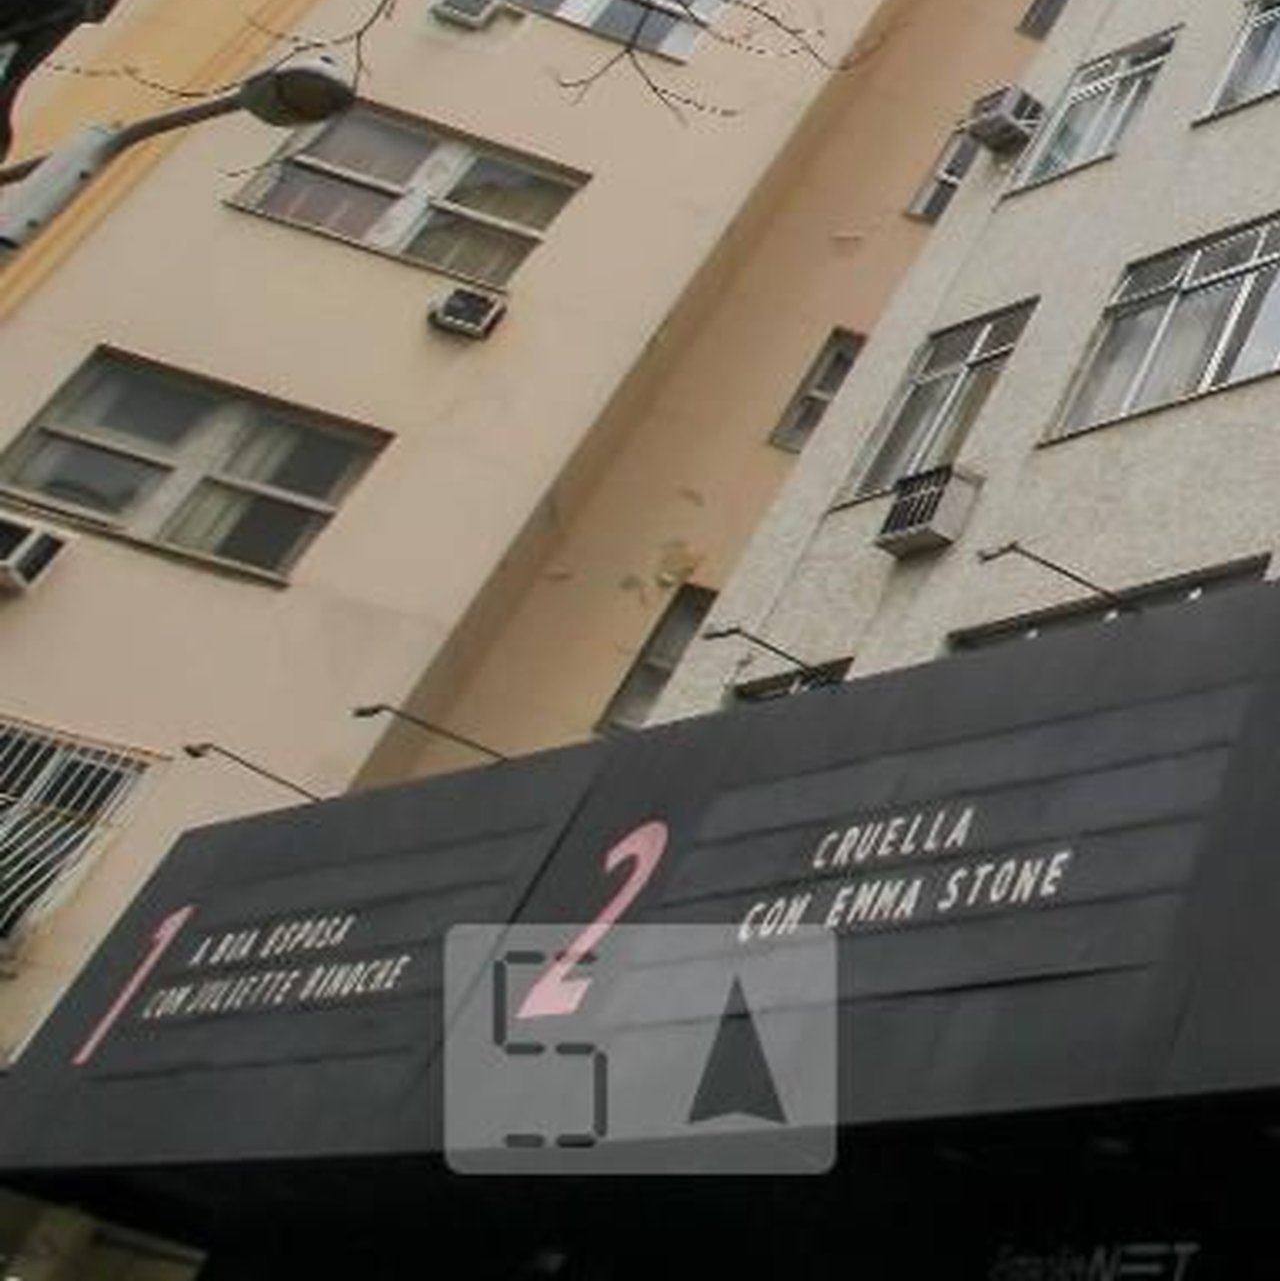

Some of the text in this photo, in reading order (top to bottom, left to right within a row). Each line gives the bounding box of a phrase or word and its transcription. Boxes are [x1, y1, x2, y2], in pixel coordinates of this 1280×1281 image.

[812, 807, 975, 869] CRUELLA
[825, 880, 925, 928] EMMA
[937, 850, 1072, 910] STONE
[519, 821, 669, 1019] 2
[73, 905, 194, 1065] 1
